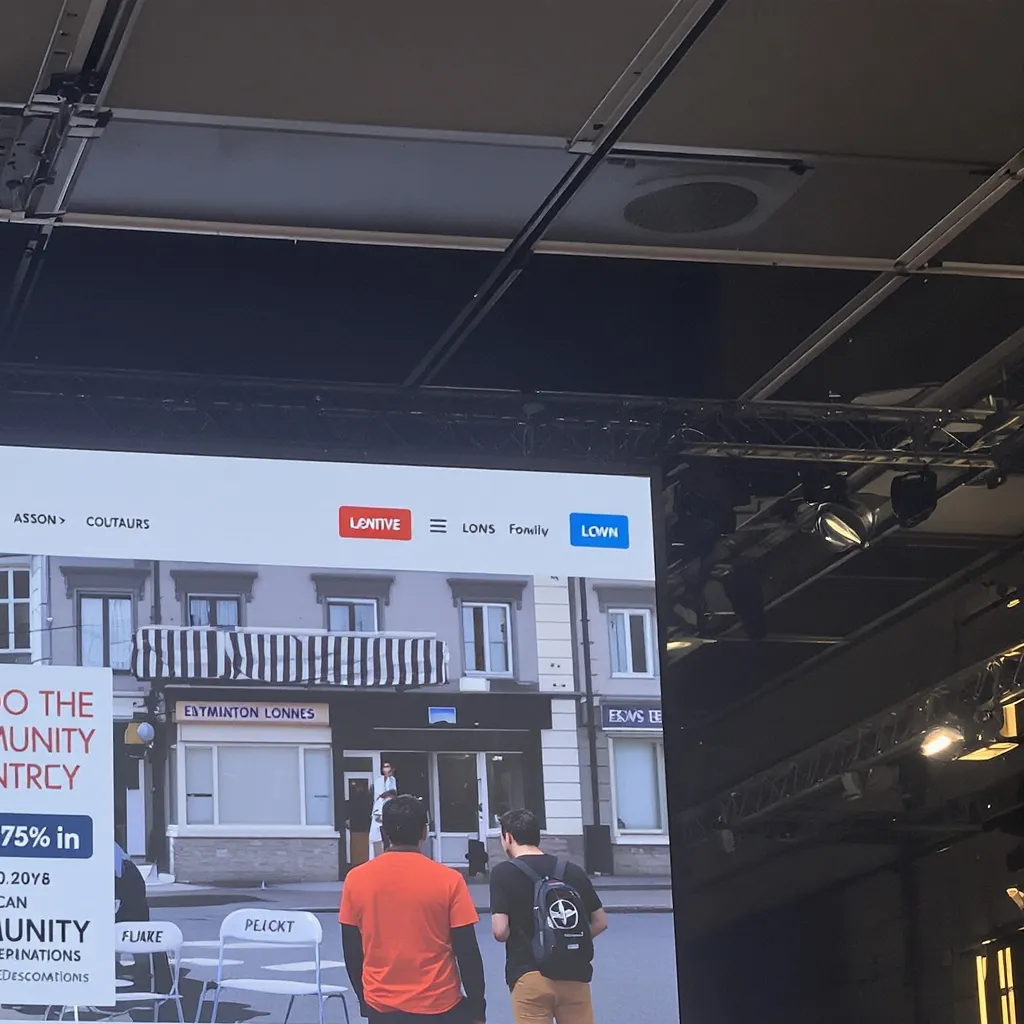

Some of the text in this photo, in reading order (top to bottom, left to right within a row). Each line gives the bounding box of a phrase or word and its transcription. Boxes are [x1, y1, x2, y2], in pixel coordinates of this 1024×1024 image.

[462, 523, 496, 535] LONS
[38, 690, 94, 718] THE
[57, 825, 81, 850] in
